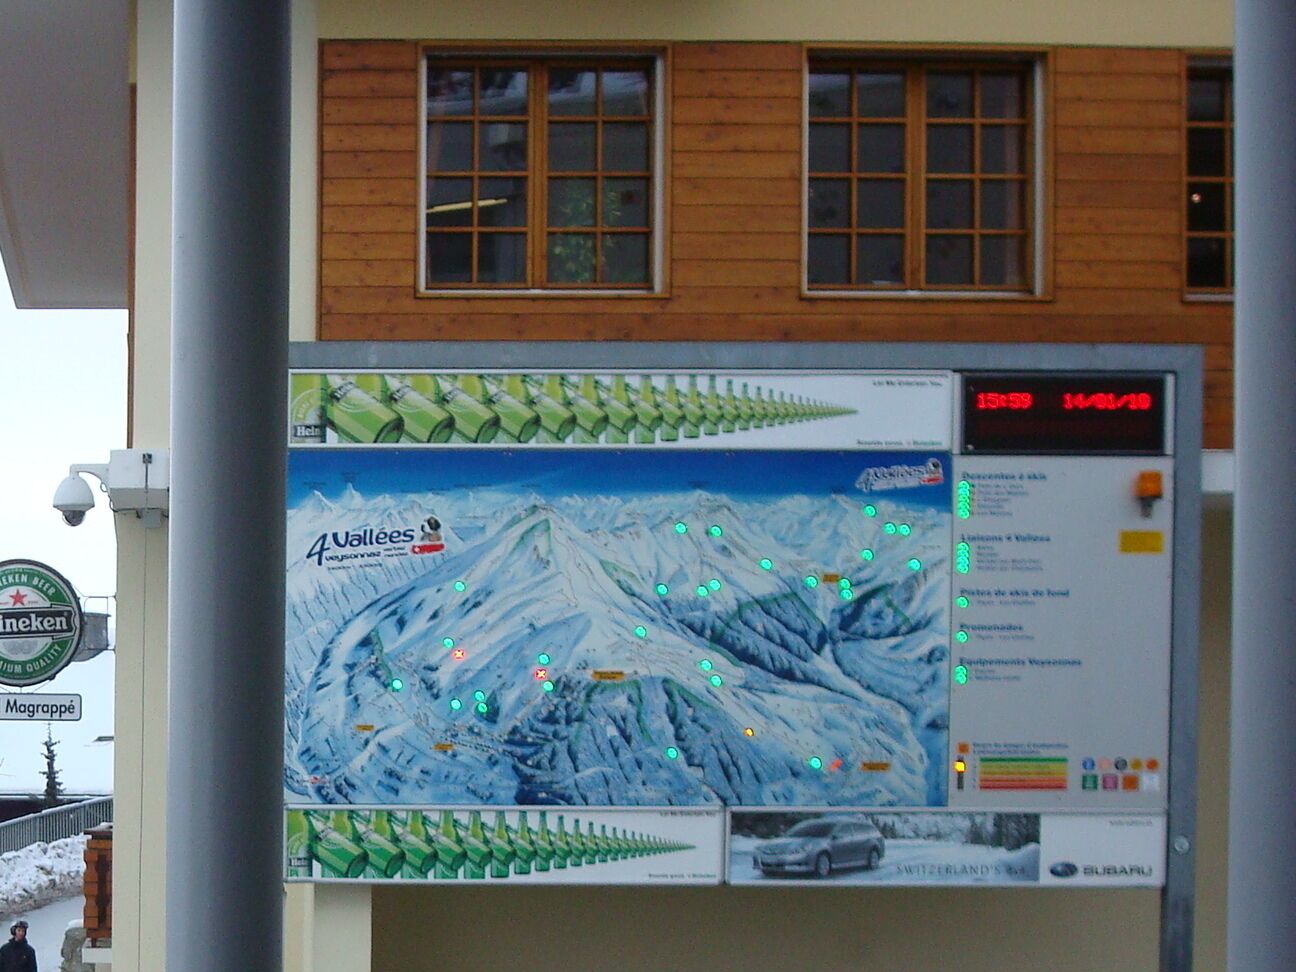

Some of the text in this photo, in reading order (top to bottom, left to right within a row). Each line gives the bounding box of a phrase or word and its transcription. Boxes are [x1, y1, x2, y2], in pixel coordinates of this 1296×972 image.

[306, 526, 415, 567] 4 Vallées
[32, 576, 56, 596] BEER
[26, 643, 62, 672] QUALITY
[5, 698, 75, 718] Magrappé
[1083, 865, 1153, 876] SUBARU
